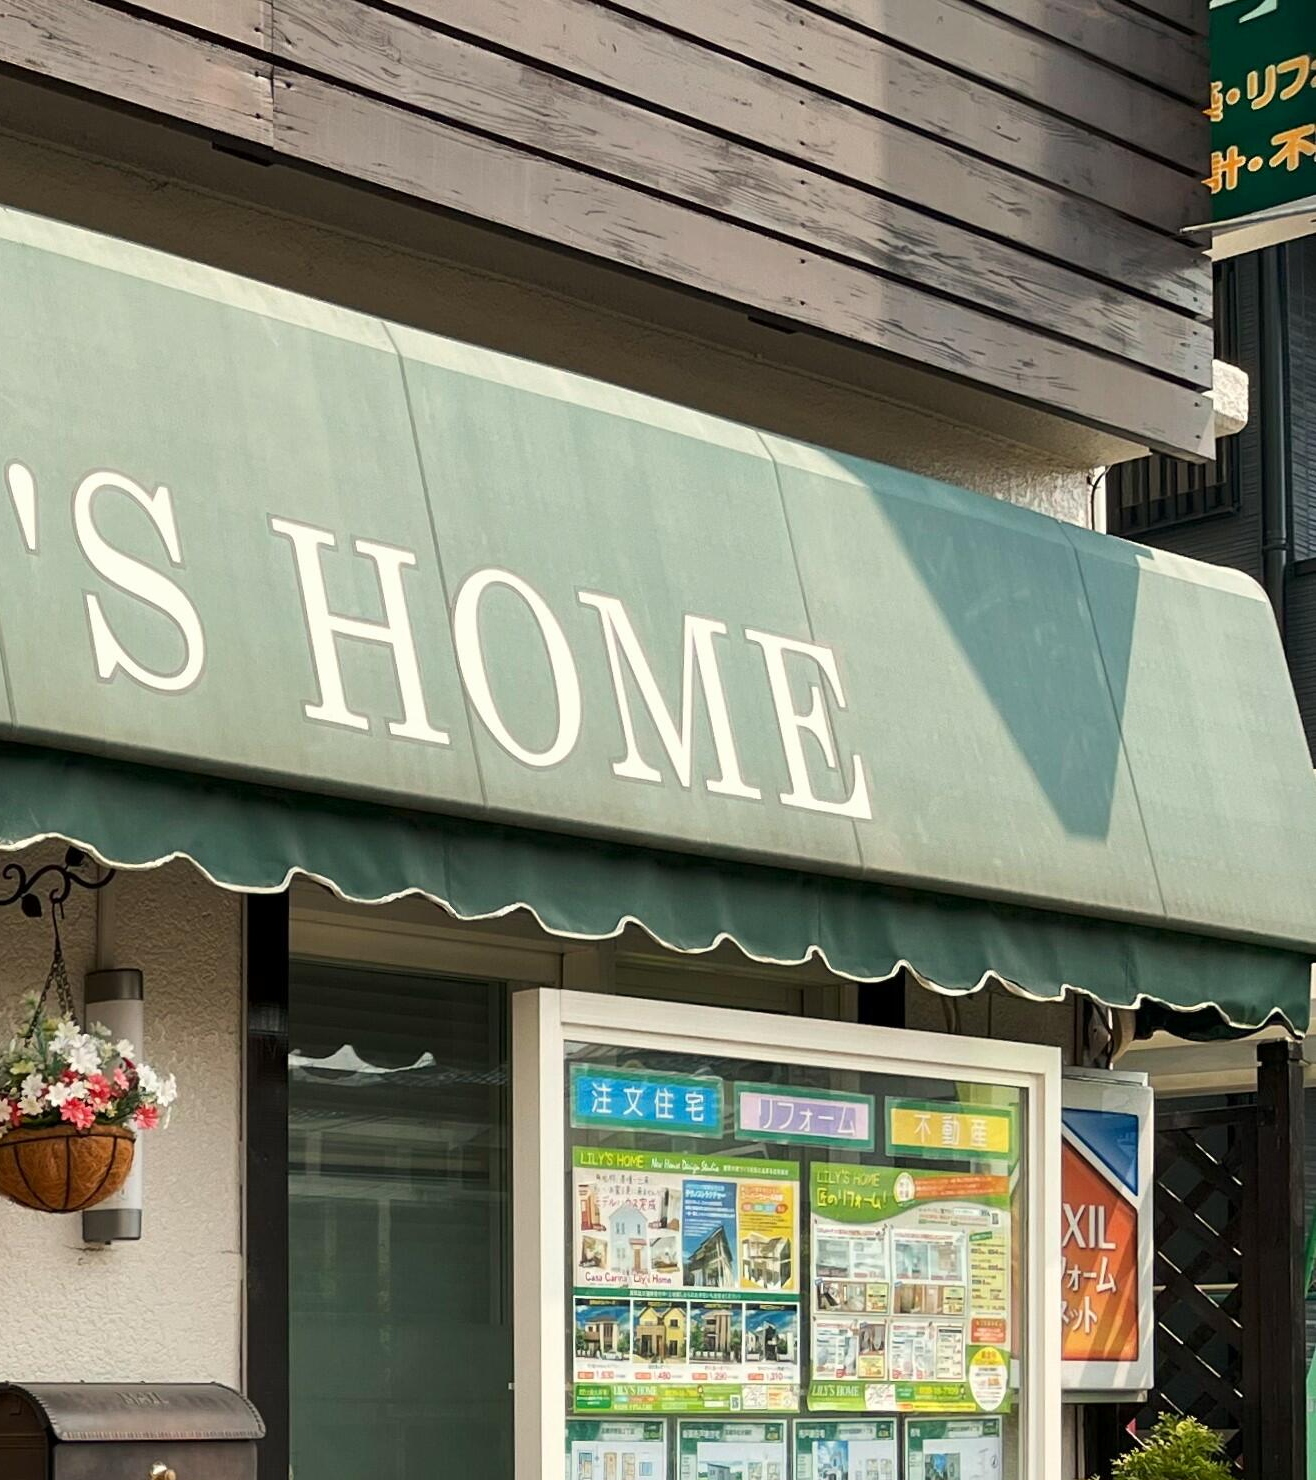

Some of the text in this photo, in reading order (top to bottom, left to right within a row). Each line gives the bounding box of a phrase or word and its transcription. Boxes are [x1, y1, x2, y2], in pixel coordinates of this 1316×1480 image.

[268, 513, 873, 821] HOME
[591, 1082, 705, 1123] 注文住宅
[758, 1097, 857, 1137] リフォーム
[913, 1113, 988, 1148] 不動産
[580, 1151, 613, 1166] LILY'S
[616, 1154, 644, 1168] HOME
